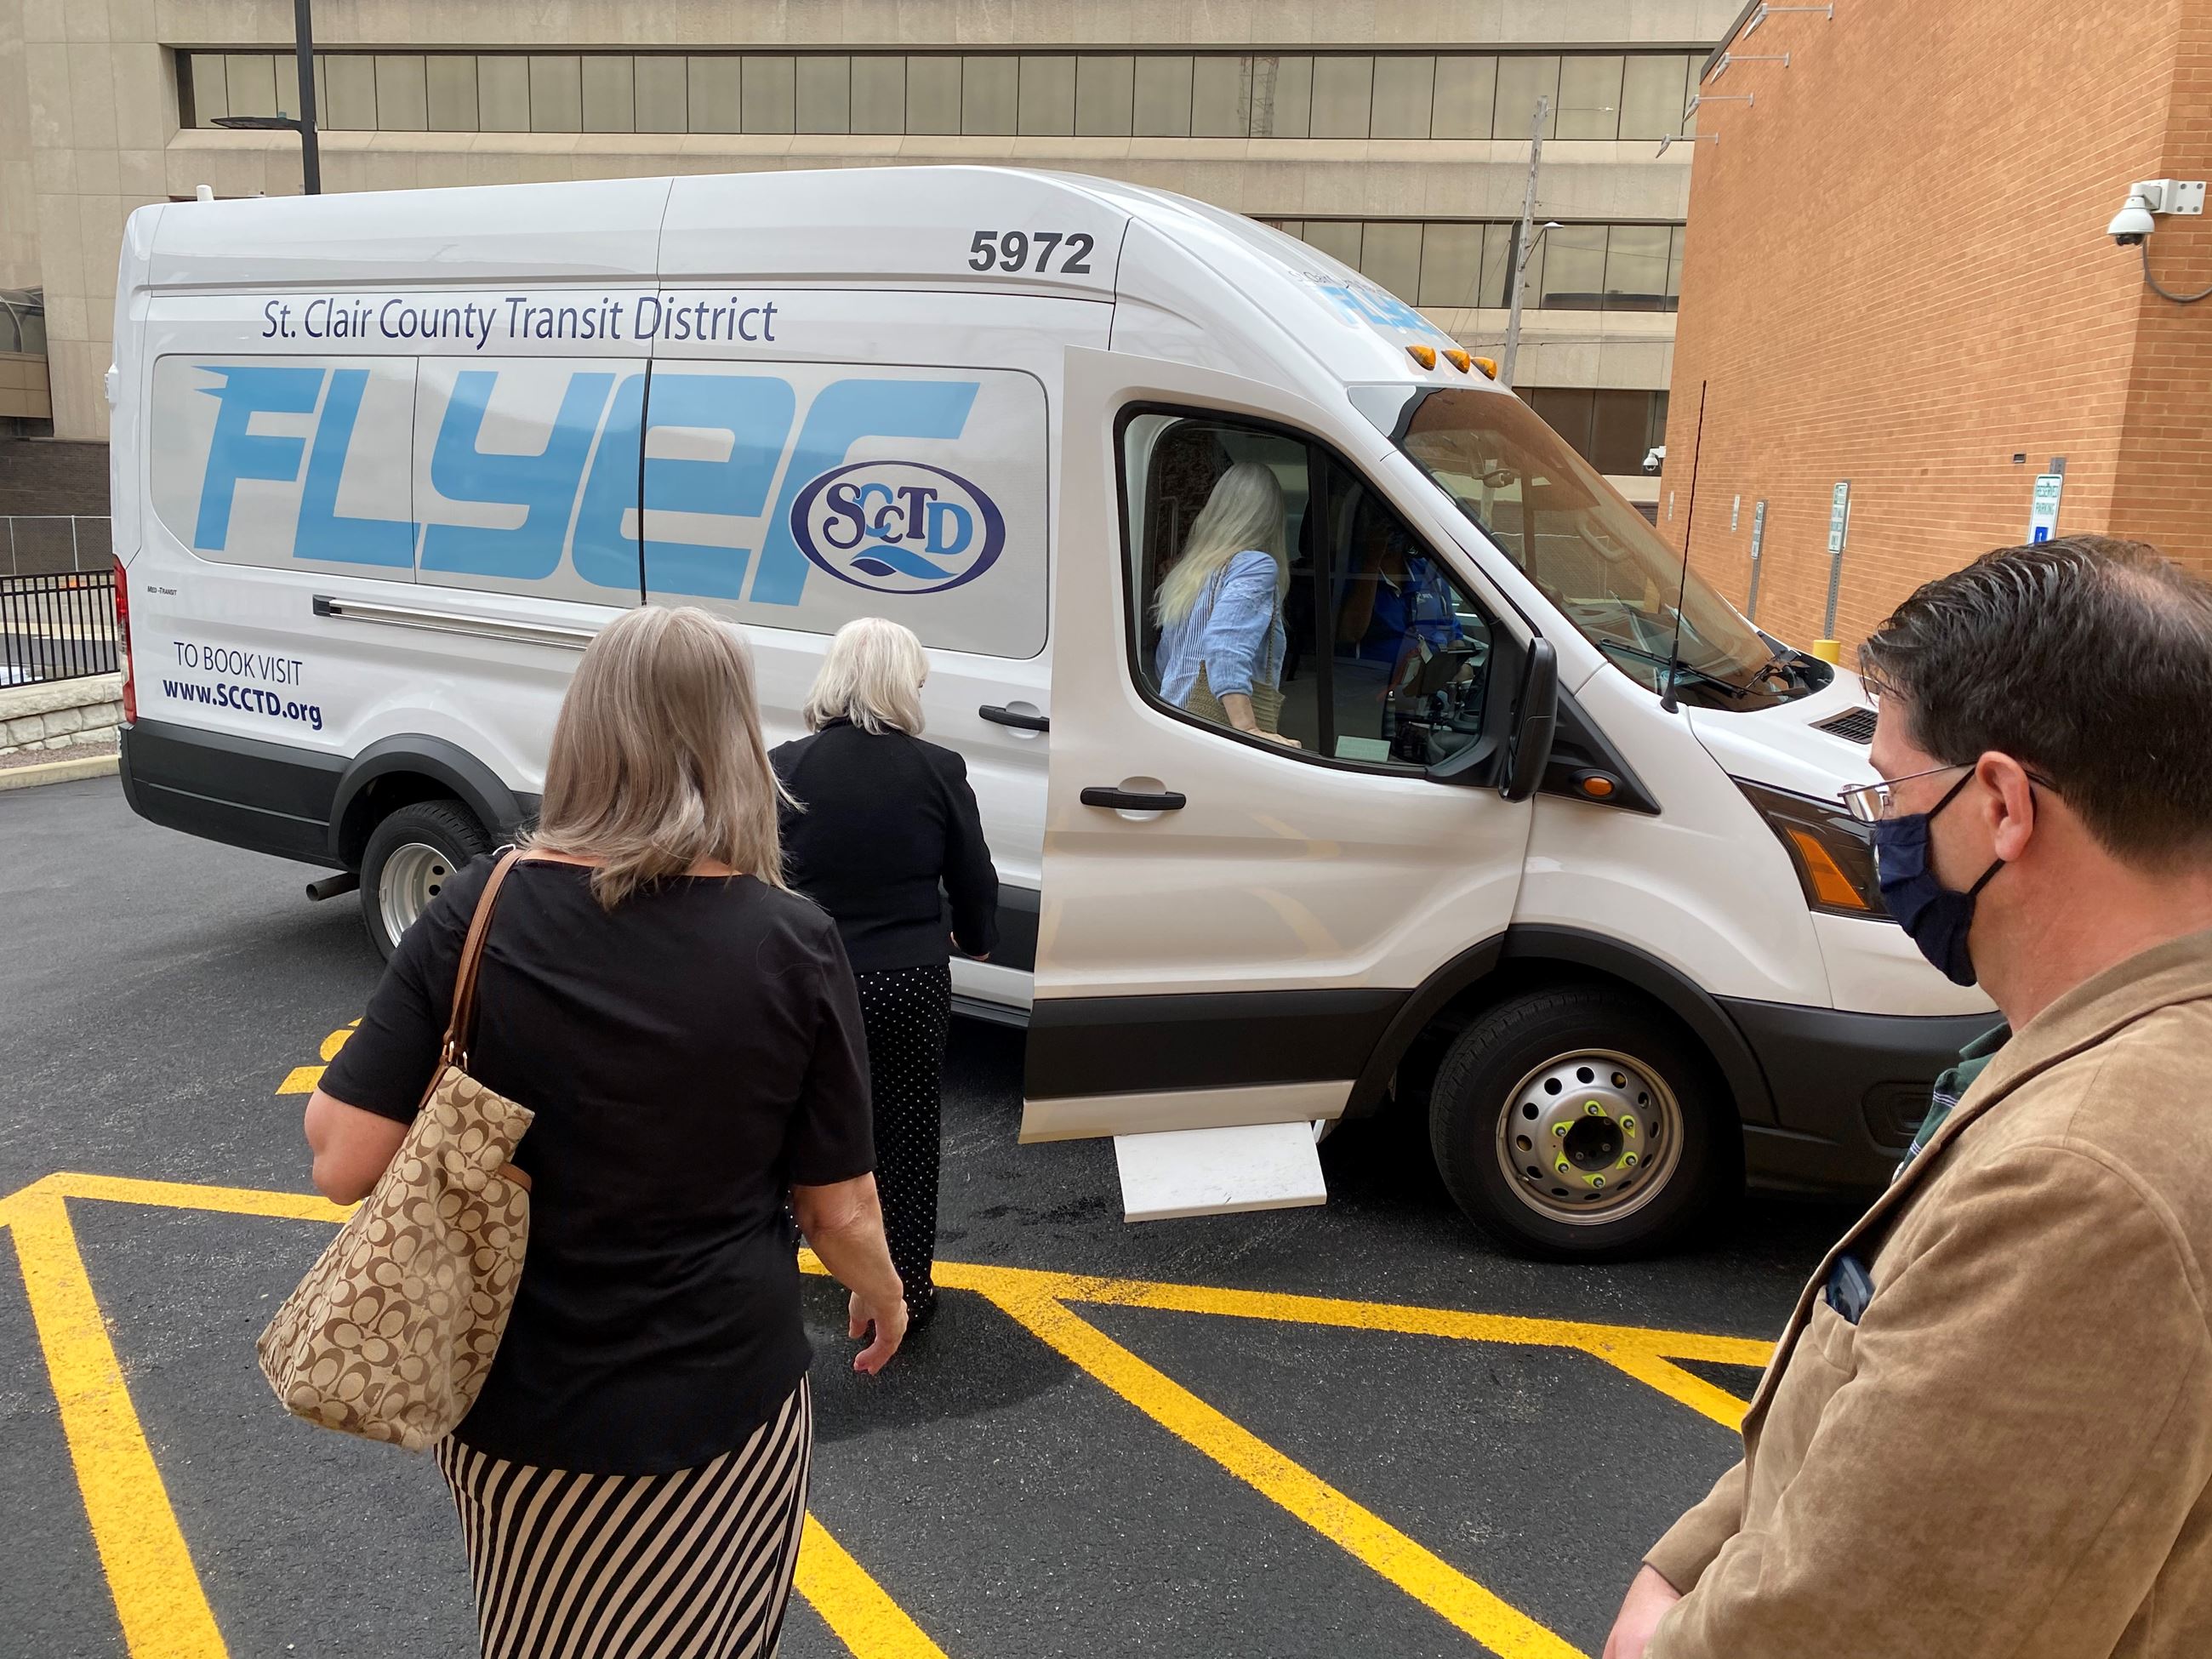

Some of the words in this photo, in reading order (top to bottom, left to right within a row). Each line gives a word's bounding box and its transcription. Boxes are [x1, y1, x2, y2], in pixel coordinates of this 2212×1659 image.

[968, 231, 1094, 274] 5972
[262, 299, 296, 338] St.
[304, 298, 373, 338] Clair
[379, 299, 497, 351] County
[505, 297, 623, 339] Transit
[634, 296, 778, 341] District
[174, 641, 198, 668] TO
[203, 647, 255, 678] BOOK
[258, 653, 303, 686] VISIT
[162, 680, 322, 731] www.SCCTD.org
